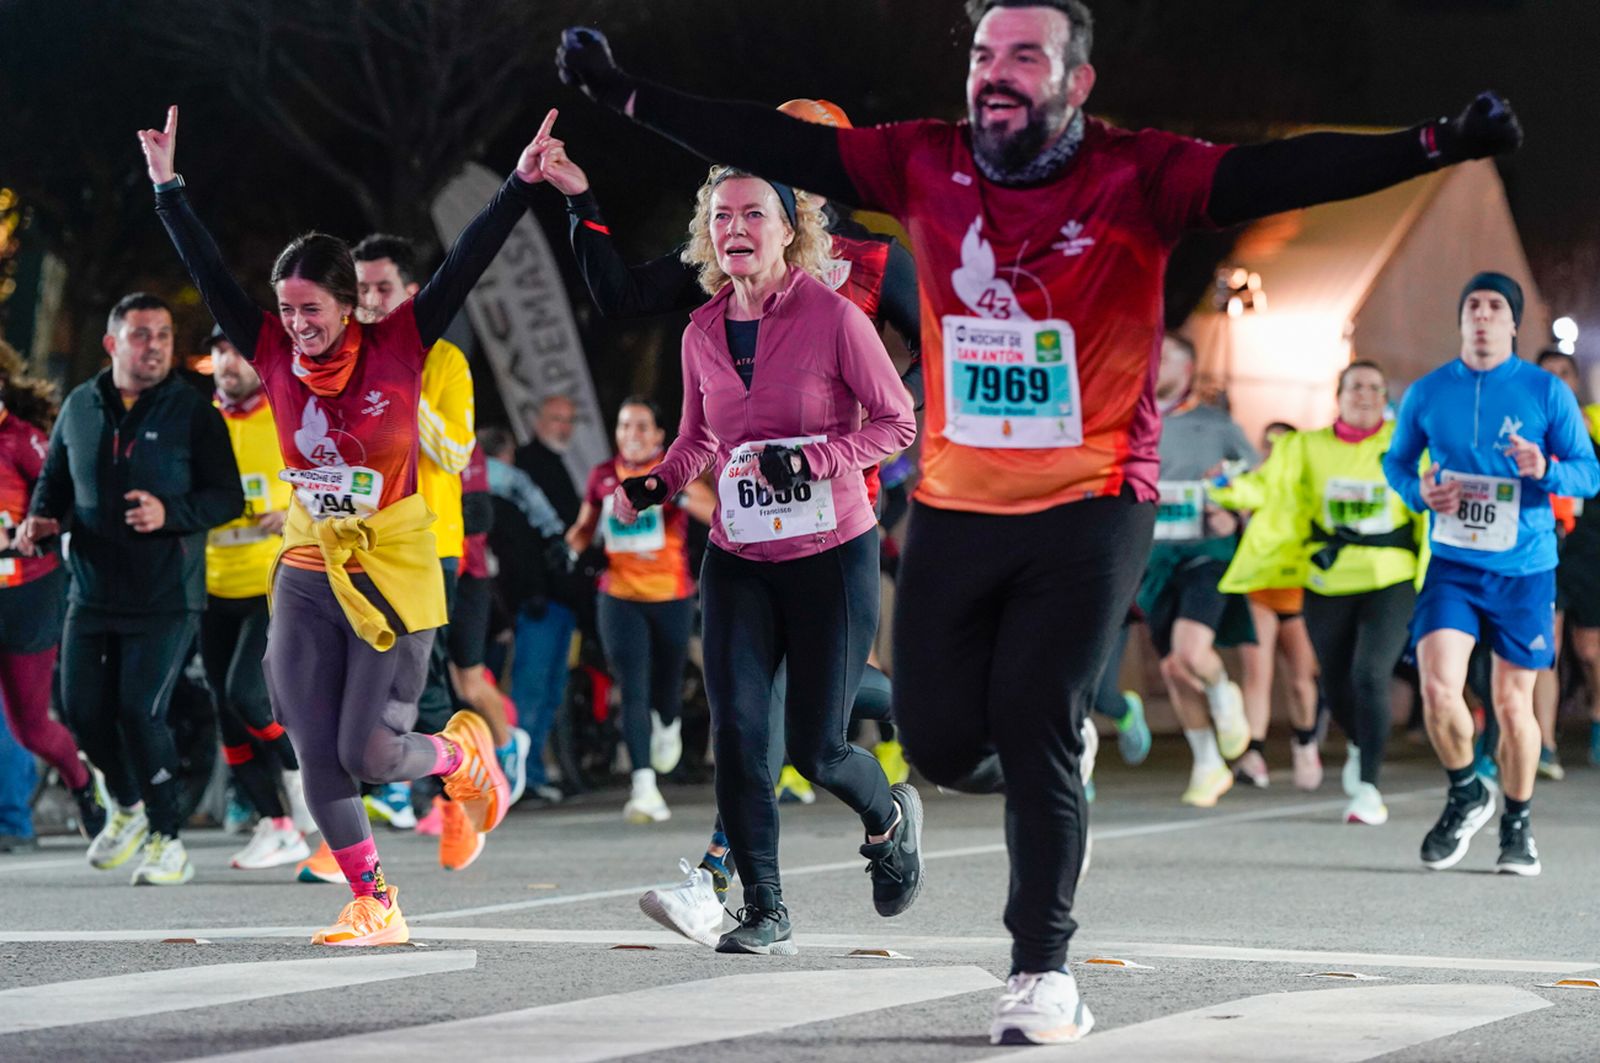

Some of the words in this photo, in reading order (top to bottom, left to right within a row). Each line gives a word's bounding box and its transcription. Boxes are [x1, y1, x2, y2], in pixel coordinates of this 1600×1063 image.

[976, 288, 1011, 320] 43
[965, 365, 1050, 404] 7969
[310, 444, 337, 466] 43
[760, 507, 792, 517] Francisco
[1457, 499, 1496, 524] 806
